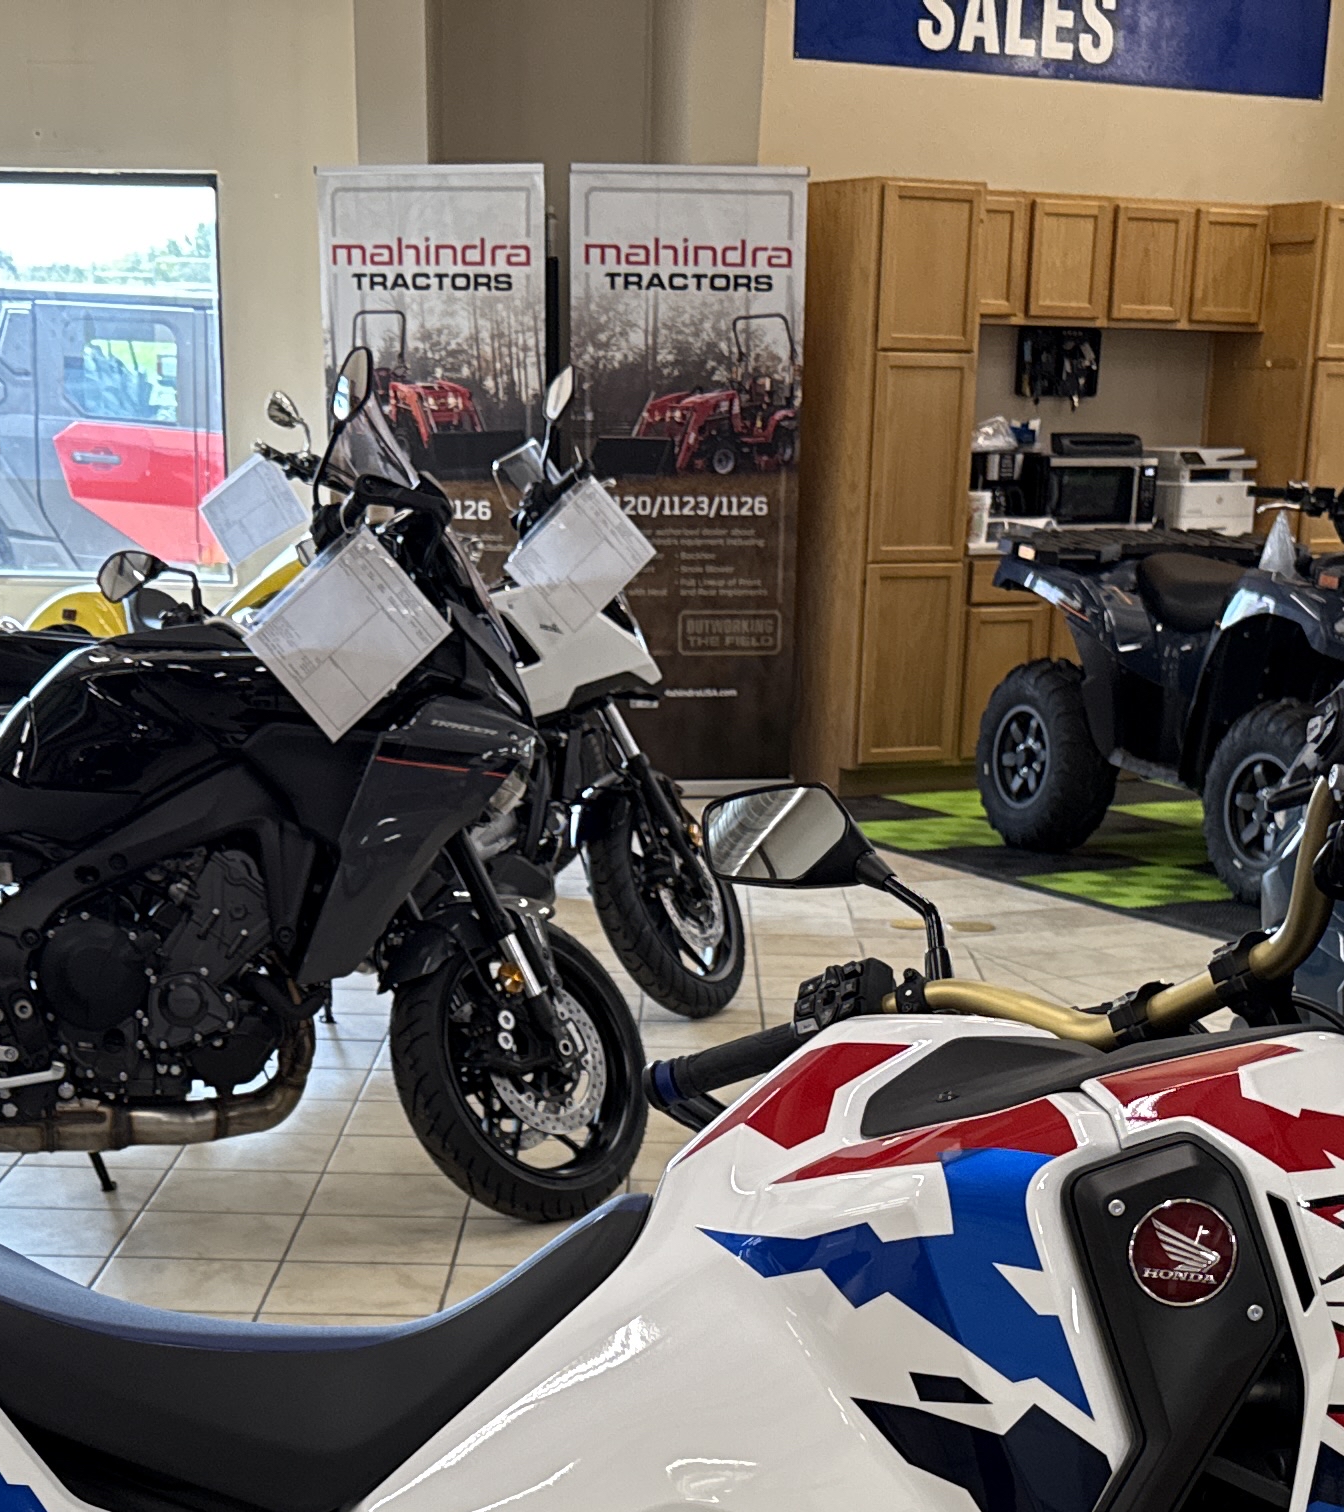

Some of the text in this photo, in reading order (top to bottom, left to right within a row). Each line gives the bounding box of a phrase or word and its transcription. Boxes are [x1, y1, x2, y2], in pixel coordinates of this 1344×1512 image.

[918, 0, 1116, 64] SALES
[331, 237, 532, 267] mahindra
[584, 238, 793, 268] mahindra
[352, 272, 513, 291] TRACTORS
[605, 272, 774, 293] TRACTORS
[613, 496, 769, 519] 120/1123/1126
[685, 618, 774, 634] OUTWORKING
[686, 636, 774, 647] THE FIELD
[430, 719, 499, 736] TRACER
[1142, 1266, 1219, 1285] HONDA
